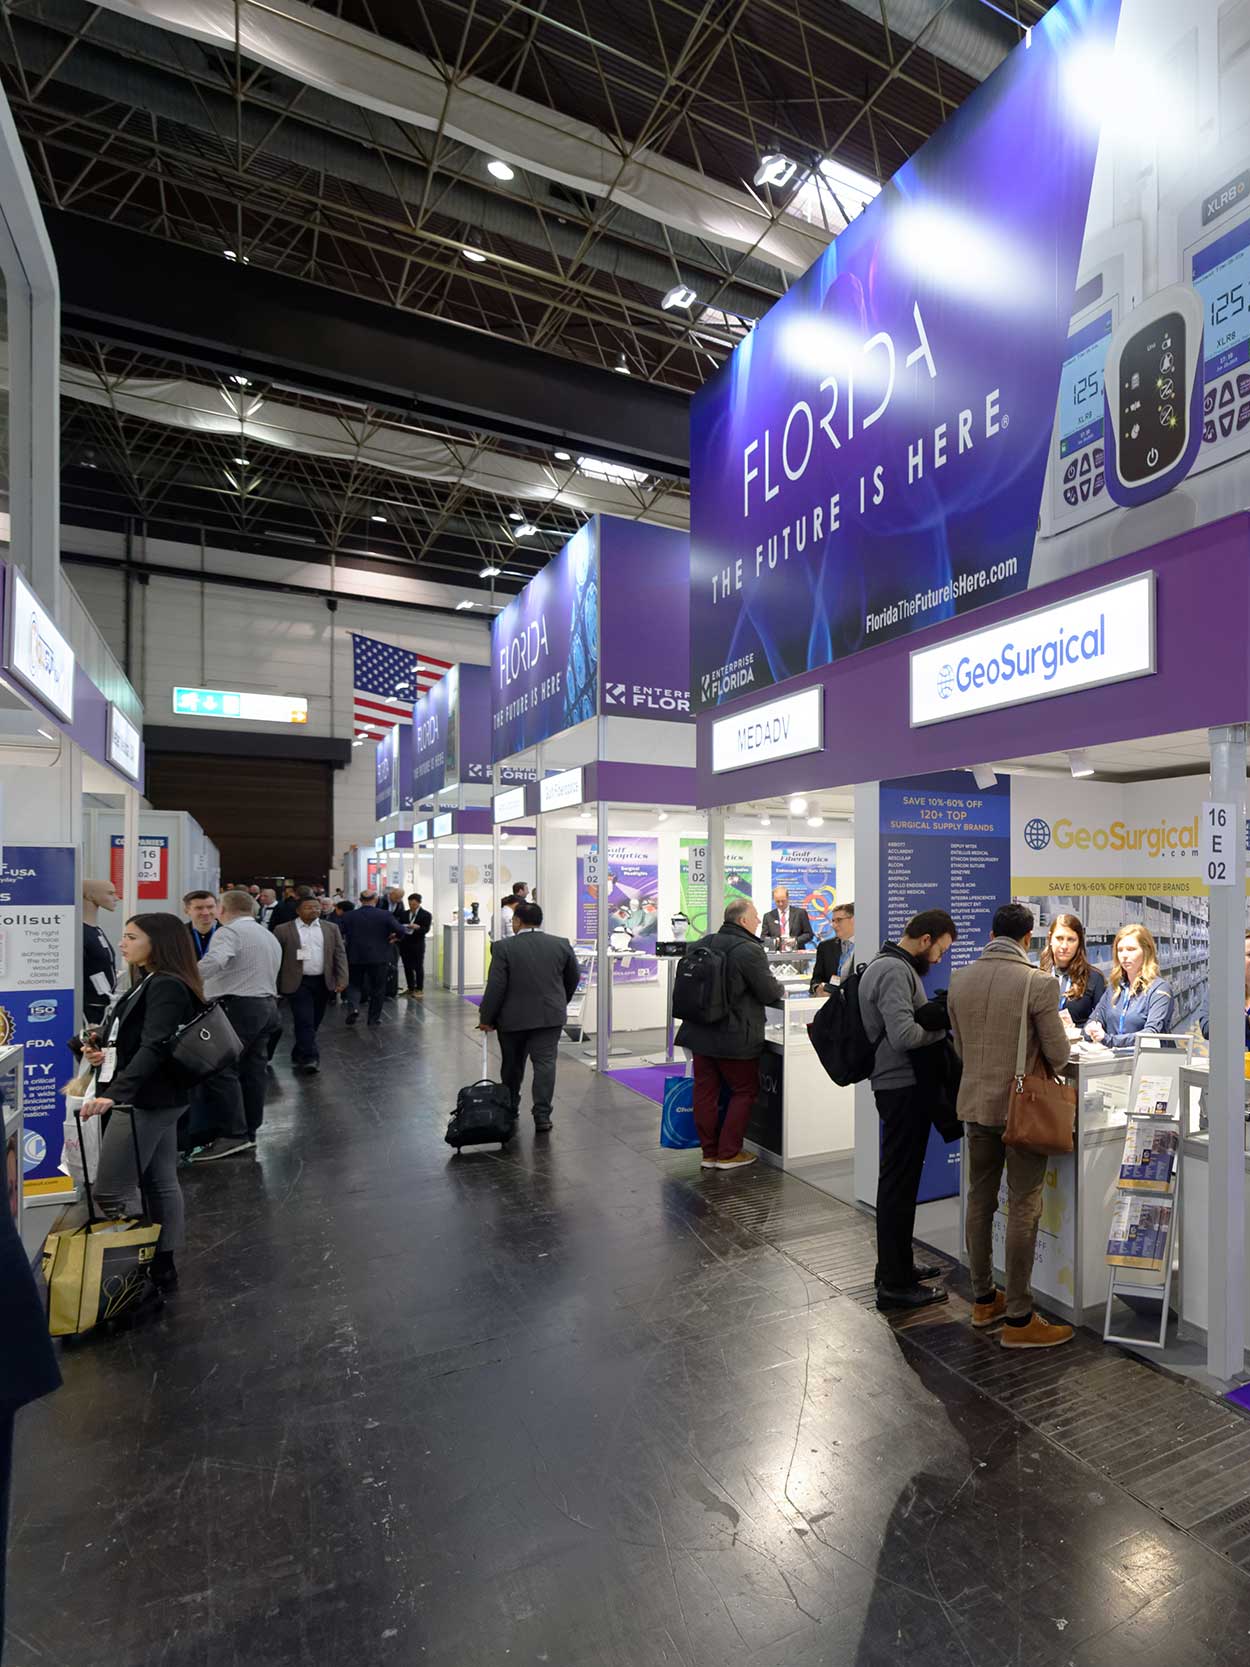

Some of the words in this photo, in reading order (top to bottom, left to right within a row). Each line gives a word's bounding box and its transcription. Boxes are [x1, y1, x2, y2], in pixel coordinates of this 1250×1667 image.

[1206, 186, 1238, 217] XLR8
[1211, 283, 1244, 326] 125
[1216, 331, 1236, 349] XLR8
[1073, 371, 1098, 406] 125
[744, 301, 937, 517] FLORIDA
[712, 557, 743, 604] THE
[756, 493, 840, 578] FUTURE
[860, 465, 885, 513] IS
[866, 557, 1017, 634] FloridaTheFutureIsHere.com
[500, 614, 549, 690] FLORIDA
[956, 613, 1105, 693] GeoSurgical
[712, 653, 754, 681] ENTERPRISE
[712, 667, 755, 698] FLORIDA
[493, 710, 505, 731] THE
[506, 698, 528, 723] FUTURE
[531, 686, 538, 706] IS
[541, 672, 561, 698] HERE
[633, 695, 690, 712] FLOR
[417, 714, 439, 753] FLORIDA
[738, 714, 790, 753] MEDADV
[486, 764, 537, 773] ETERPRI
[903, 797, 926, 806] SAVE
[928, 798, 964, 808] 10%-60%
[967, 800, 983, 808] OFF
[920, 810, 943, 820] 120+
[947, 811, 967, 821] TOP
[1208, 808, 1226, 826] 16
[890, 821, 931, 830] SURGICAL
[933, 822, 961, 831] SUPPLY
[964, 824, 994, 832] BRANDS
[1051, 816, 1199, 858] GeoSurgical
[1212, 835, 1222, 853] E
[142, 850, 156, 859] 16
[587, 856, 598, 864] 16
[692, 848, 706, 857] 16
[144, 861, 153, 869] D
[695, 861, 702, 869] E
[1208, 862, 1226, 880] 02
[692, 873, 705, 882] 02
[1049, 883, 1070, 891] SAVE
[1072, 883, 1107, 891] 10%-60%
[1109, 883, 1124, 891] OFF
[1125, 883, 1135, 891] ON
[1136, 883, 1147, 891] 120
[1149, 883, 1161, 891] TOP
[1162, 883, 1190, 891] BRANDS
[0, 915, 61, 925] ollsut
[30, 1006, 55, 1014] ISO
[26, 1039, 54, 1048] FDA
[23, 1097, 55, 1105] linicians
